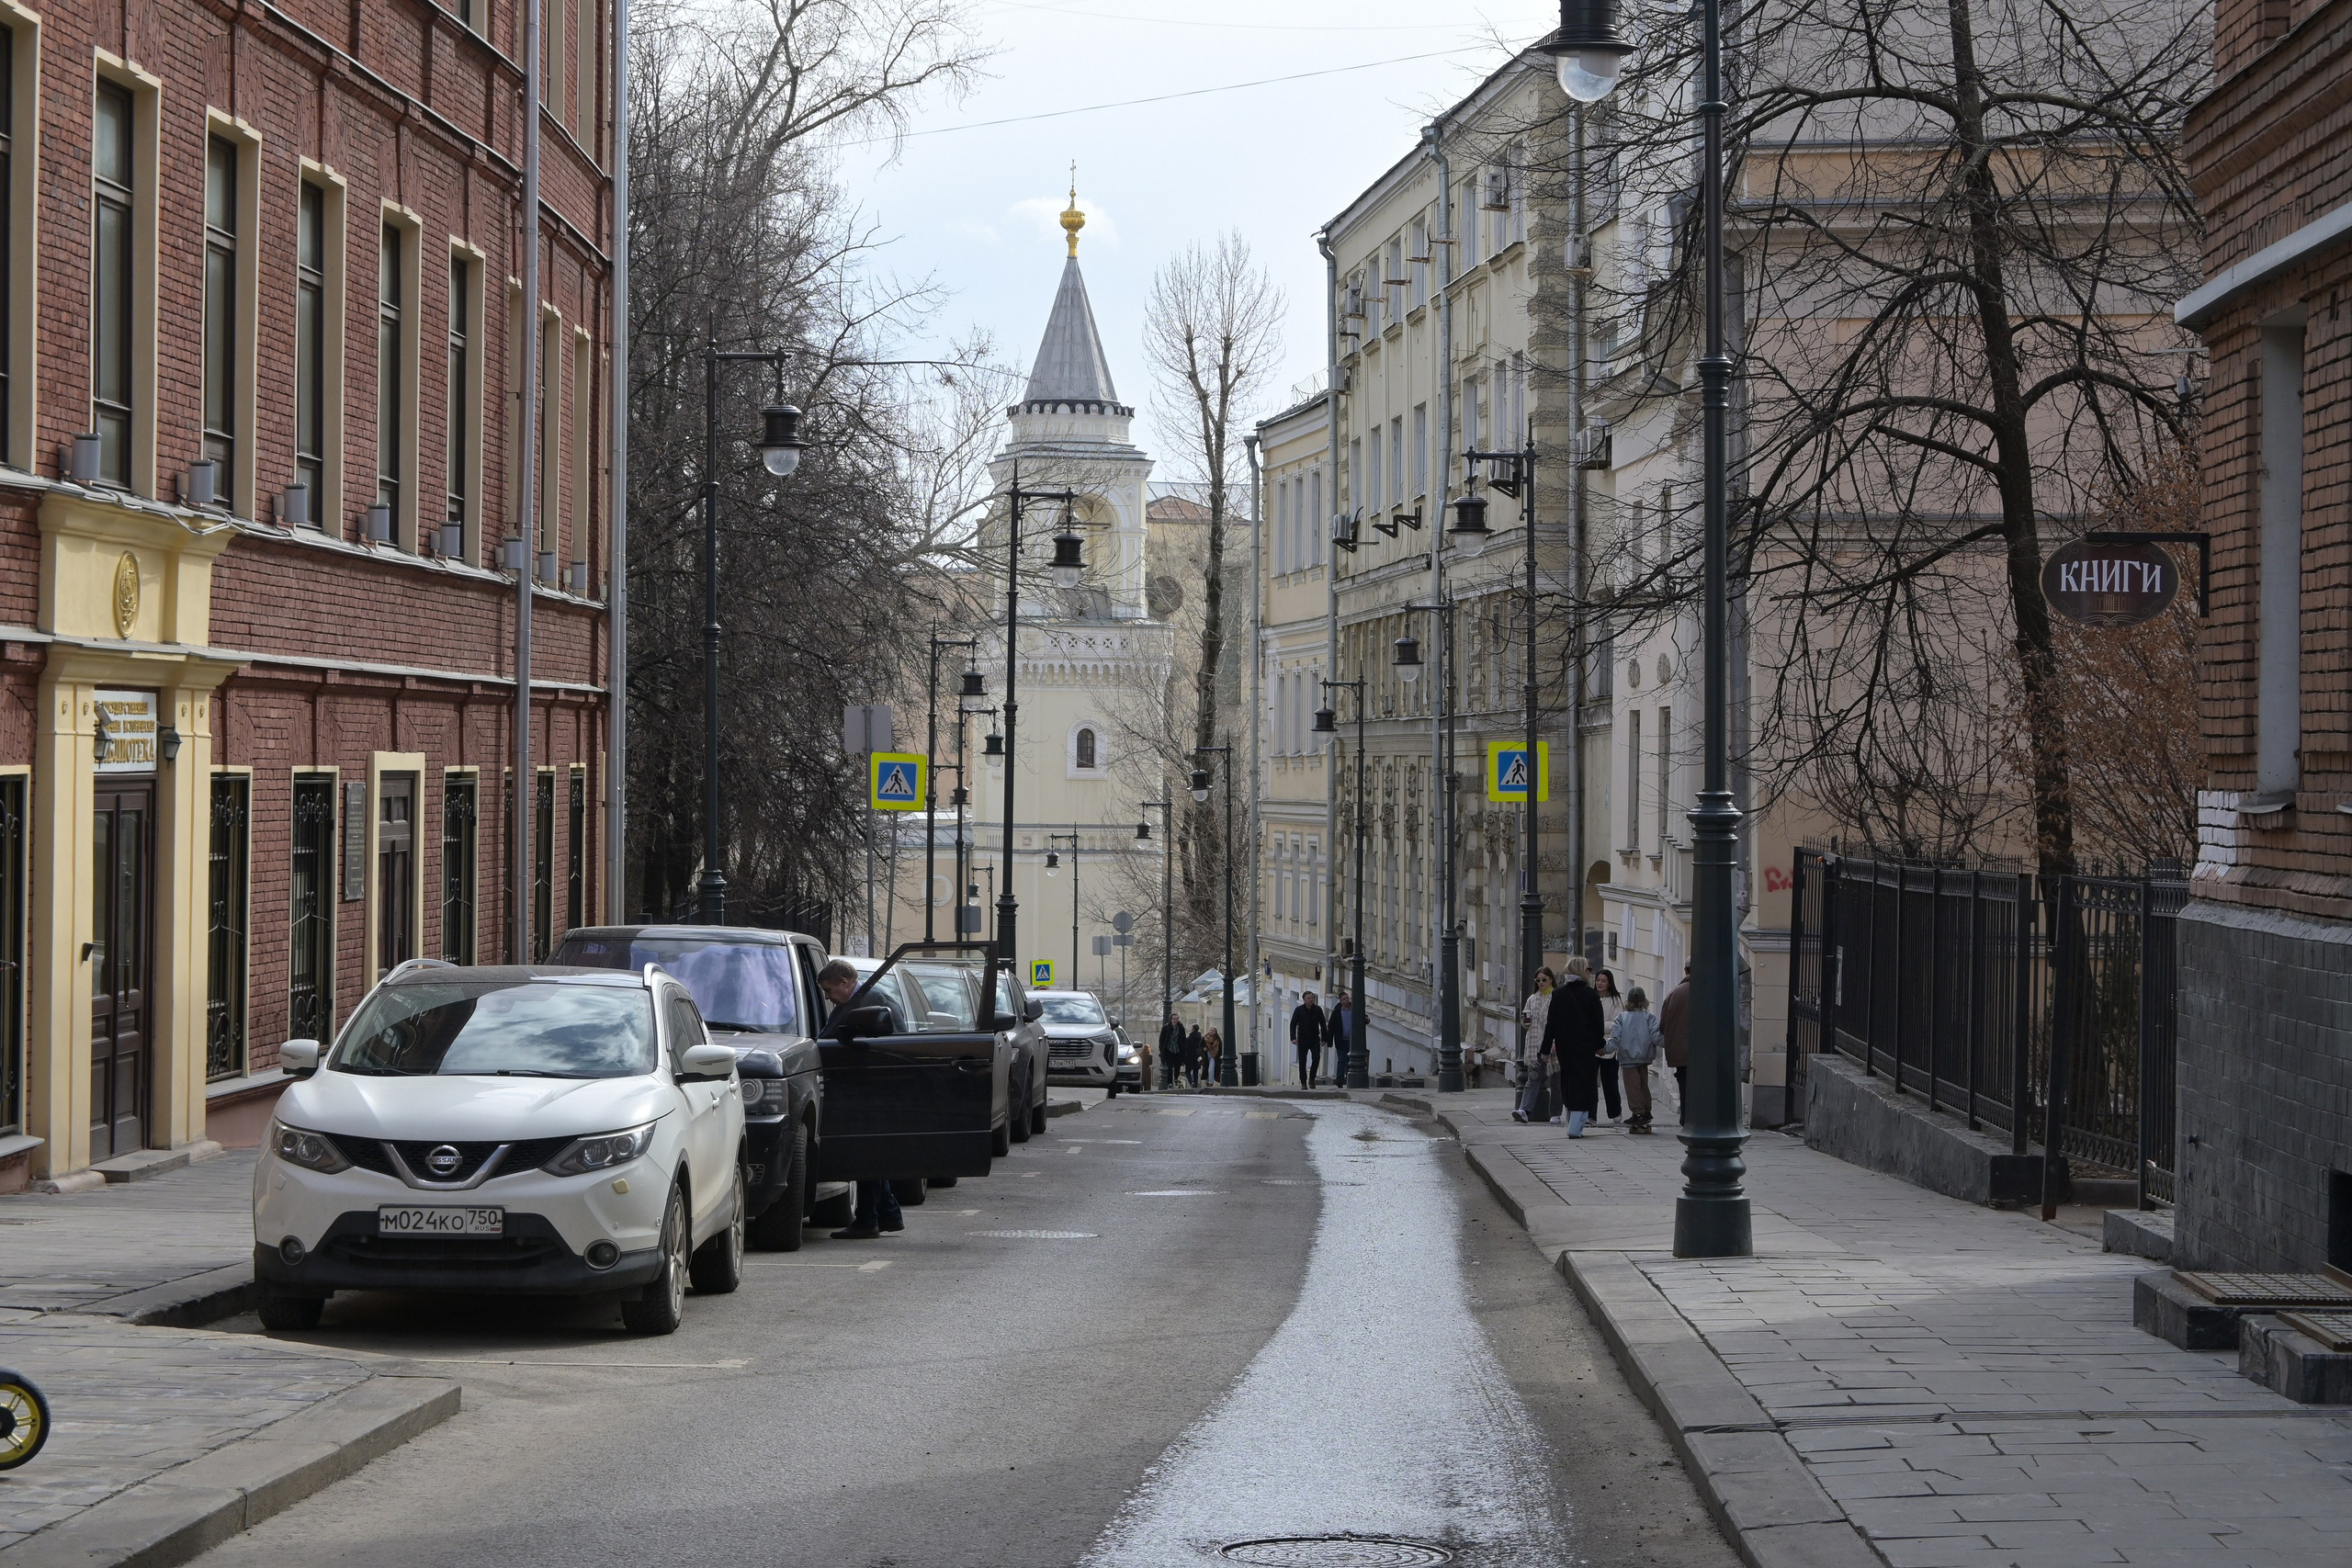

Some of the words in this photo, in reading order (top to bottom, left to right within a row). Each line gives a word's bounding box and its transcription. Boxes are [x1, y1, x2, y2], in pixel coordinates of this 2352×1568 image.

[2060, 559, 2162, 593] КНИГИ
[384, 1210, 464, 1231] М024КО
[468, 1210, 498, 1225] 750
